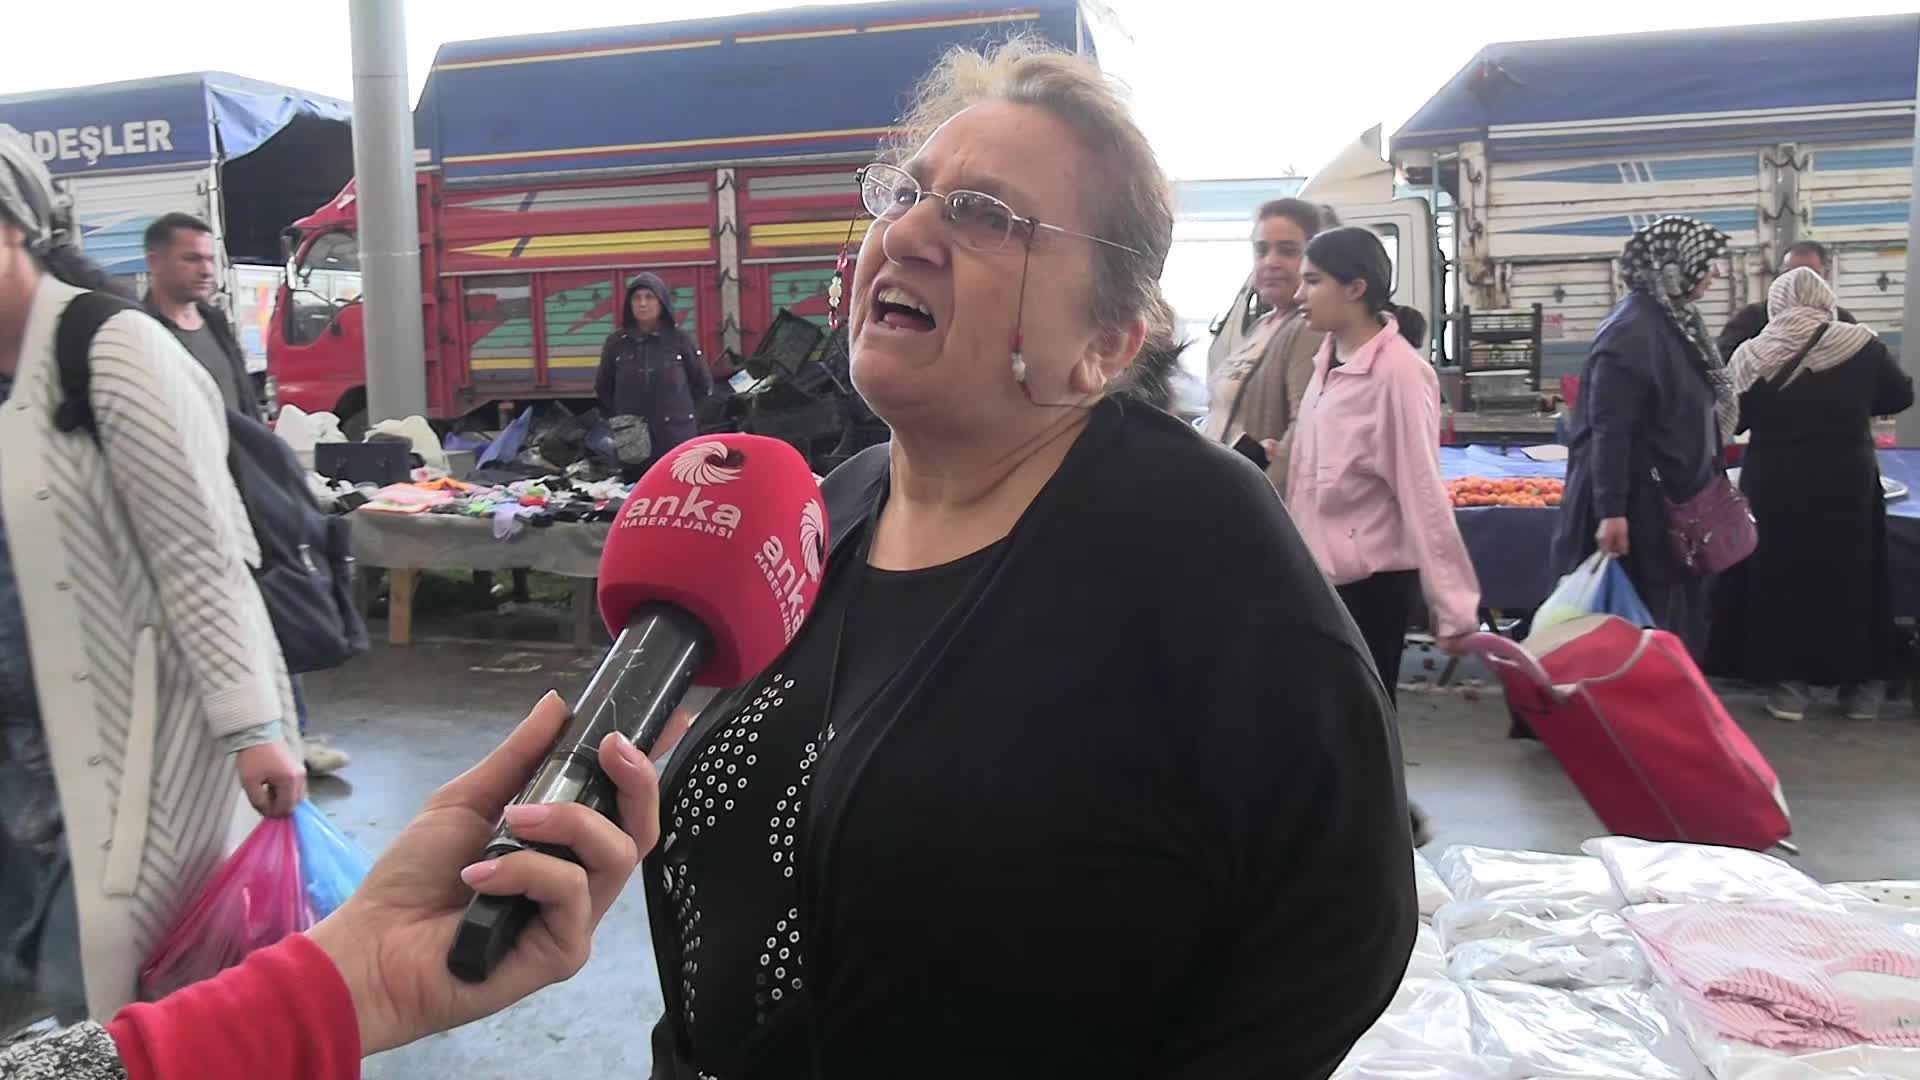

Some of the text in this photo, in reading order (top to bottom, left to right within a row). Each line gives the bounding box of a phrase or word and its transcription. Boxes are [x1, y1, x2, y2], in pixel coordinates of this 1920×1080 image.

[620, 516, 734, 539] HABER AJANSI
[625, 486, 742, 529] anka
[754, 551, 783, 600] HABER
[763, 535, 805, 639] anka
